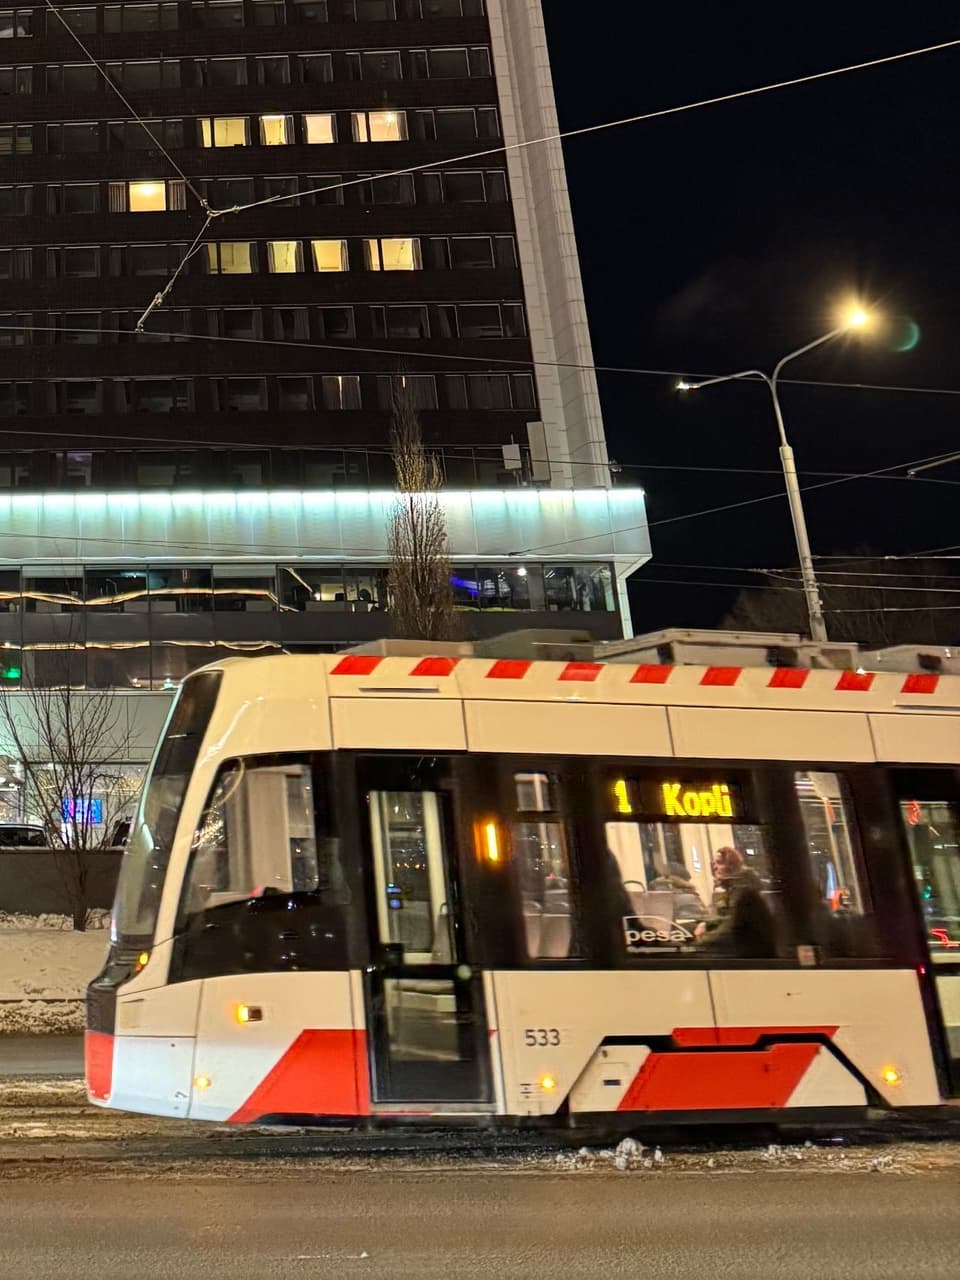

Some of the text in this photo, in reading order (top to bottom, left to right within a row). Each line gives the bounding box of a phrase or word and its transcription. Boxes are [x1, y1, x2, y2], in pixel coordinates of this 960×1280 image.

[615, 780, 733, 817] 1 Kopli
[625, 930, 686, 945] pesa
[525, 1028, 561, 1047] 533
